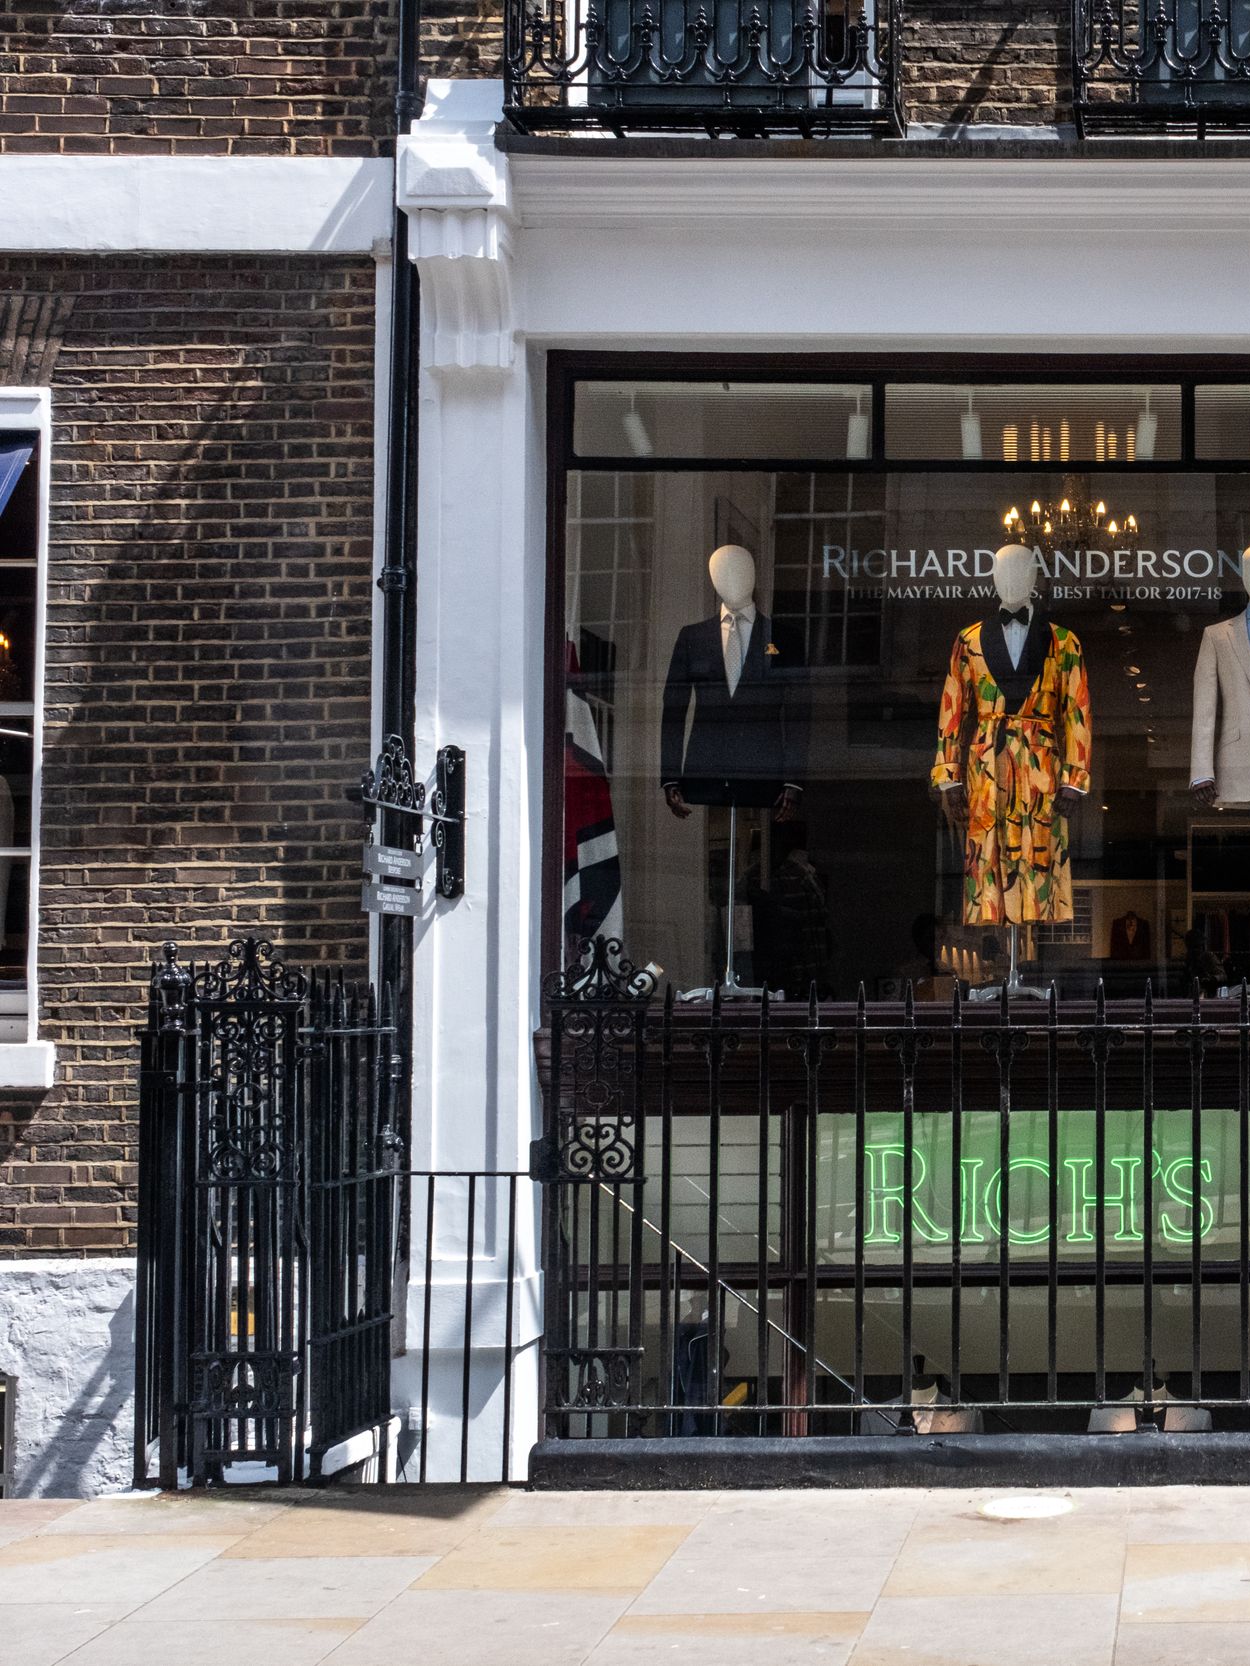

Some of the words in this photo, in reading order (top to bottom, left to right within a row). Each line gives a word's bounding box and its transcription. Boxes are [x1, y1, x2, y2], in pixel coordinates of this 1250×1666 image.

[822, 545, 997, 578] RICHARD
[1029, 545, 1243, 578] ANDERSON
[847, 586, 883, 599] THE
[887, 585, 962, 599] MAYFAIR
[967, 585, 1043, 600] AWAS,
[1053, 586, 1093, 600] BEST
[1100, 586, 1161, 600] TAILOR
[1165, 586, 1223, 600] 2017-18
